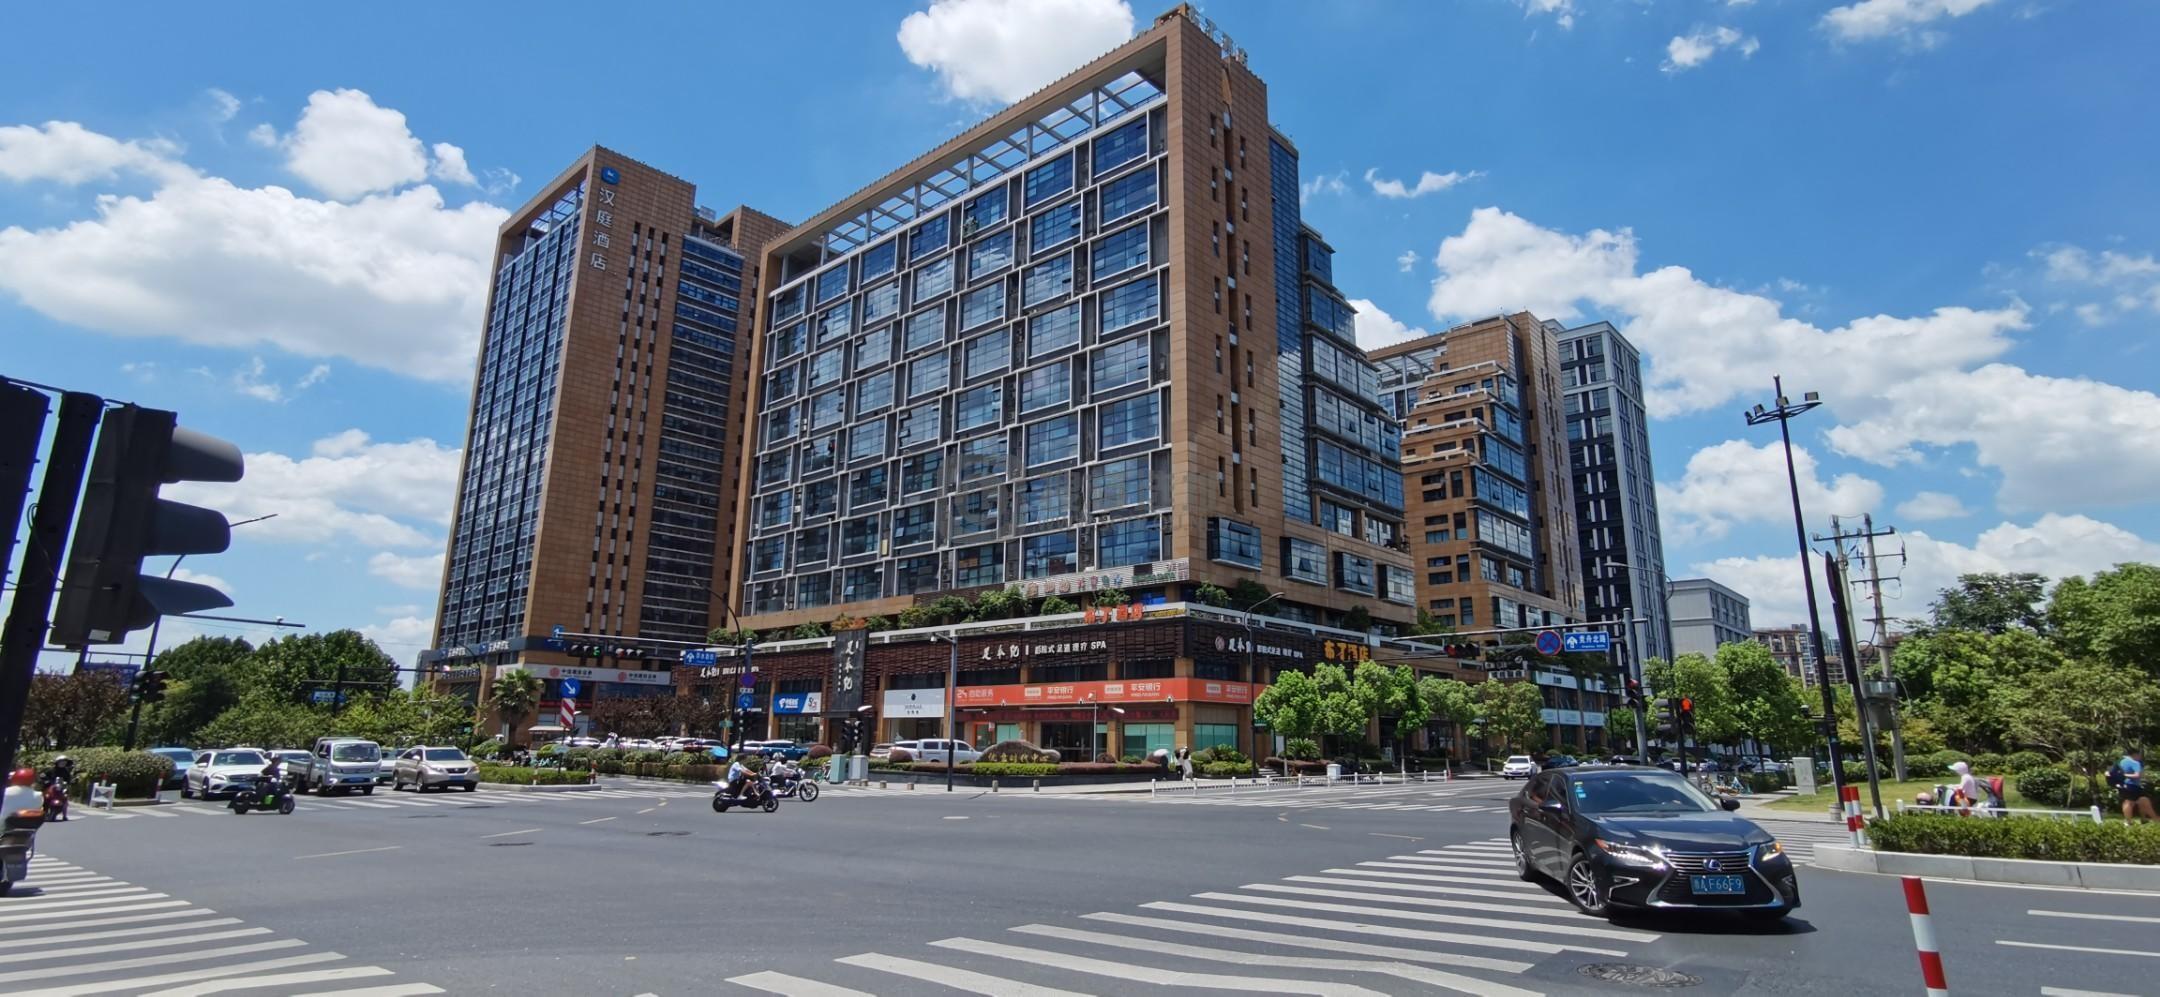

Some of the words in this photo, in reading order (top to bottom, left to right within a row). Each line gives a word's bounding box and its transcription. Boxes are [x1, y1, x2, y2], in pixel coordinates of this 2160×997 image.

[590, 186, 616, 271] 汉庭酒店
[1090, 640, 1107, 650] SPA
[1324, 640, 1369, 661] 布丁酒店
[1047, 685, 1073, 694] 平安银行
[1130, 682, 1161, 691] 平安银行
